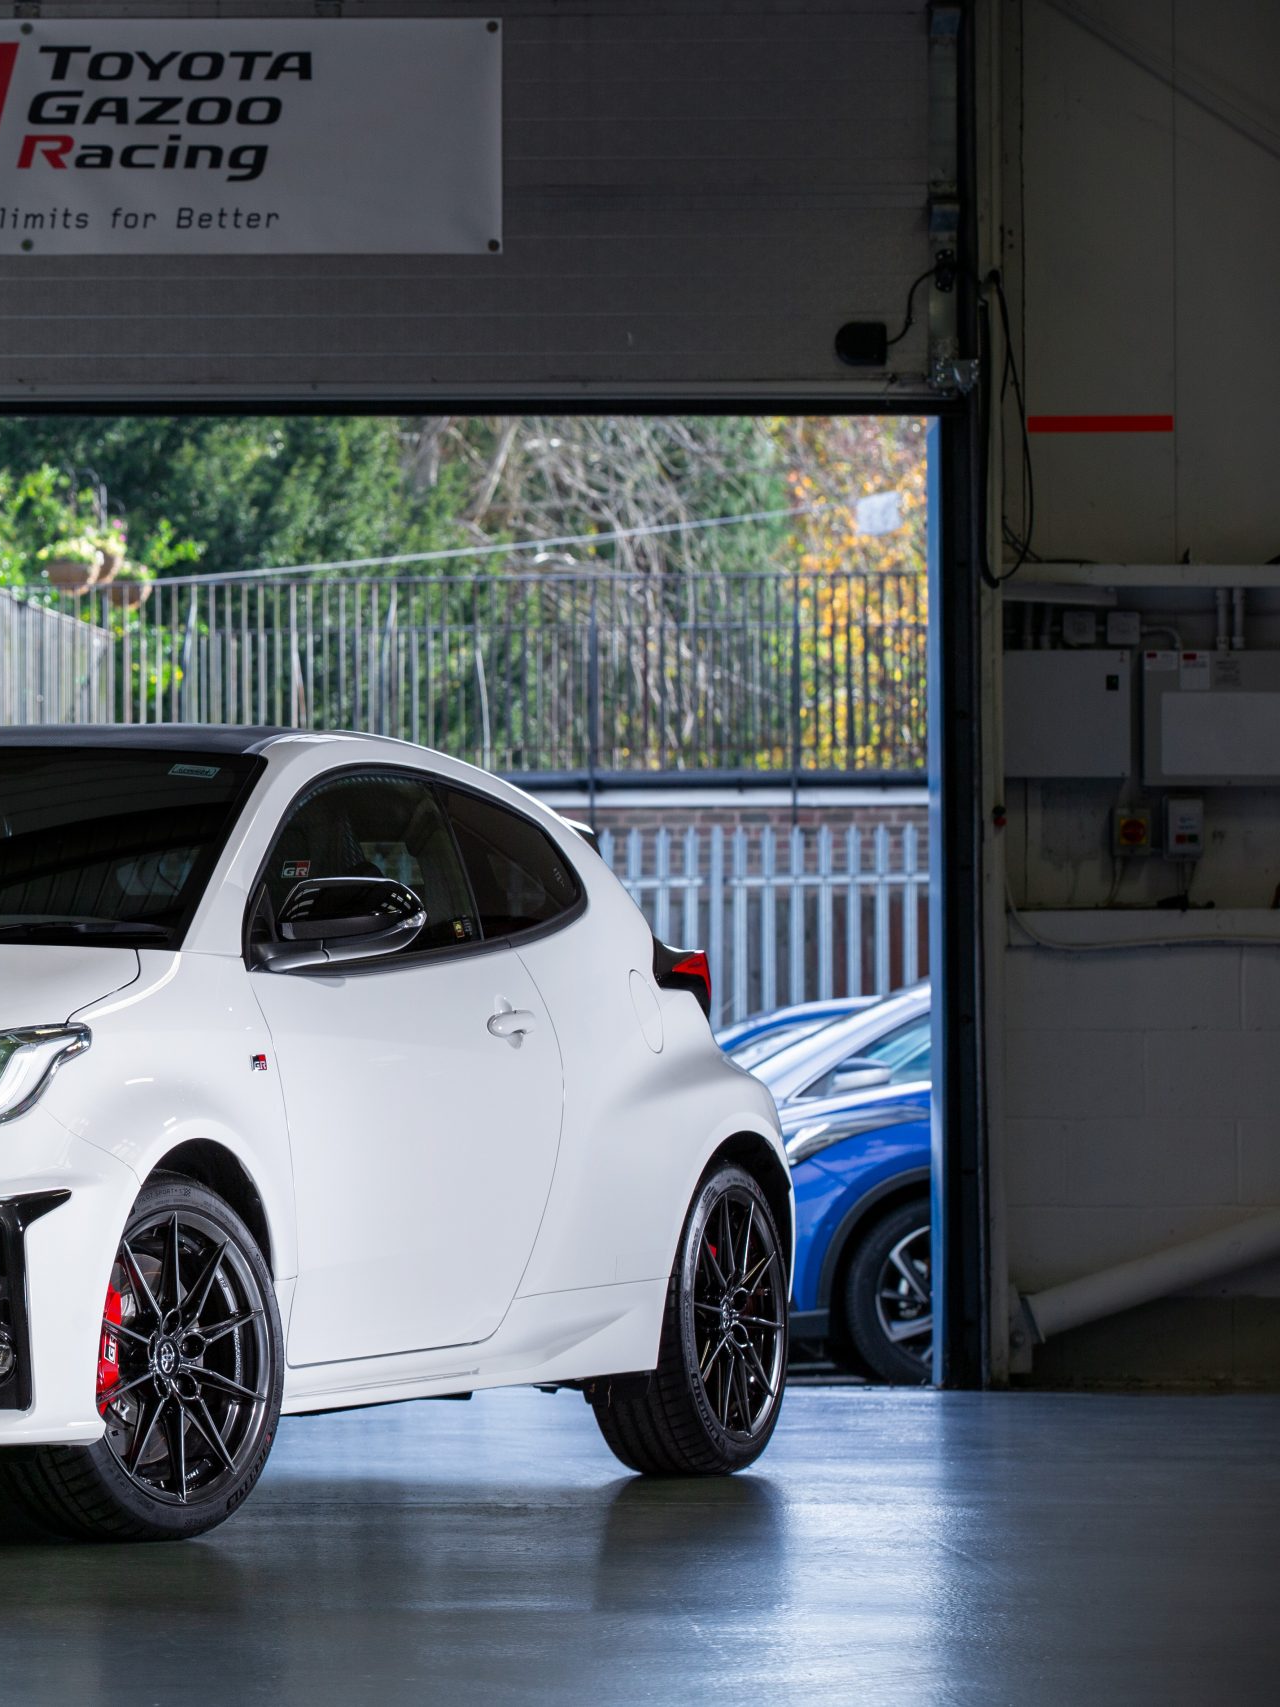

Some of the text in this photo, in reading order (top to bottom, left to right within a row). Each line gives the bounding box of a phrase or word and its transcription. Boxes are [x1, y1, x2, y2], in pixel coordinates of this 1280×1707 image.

[39, 46, 312, 81] TOYOTA
[27, 90, 282, 125] GAZOO
[17, 134, 269, 183] Racing
[0, 207, 89, 229] limits
[111, 207, 157, 229] for
[176, 207, 280, 229] Better
[283, 867, 308, 877] GR
[692, 1378, 719, 1441] MICHELIN
